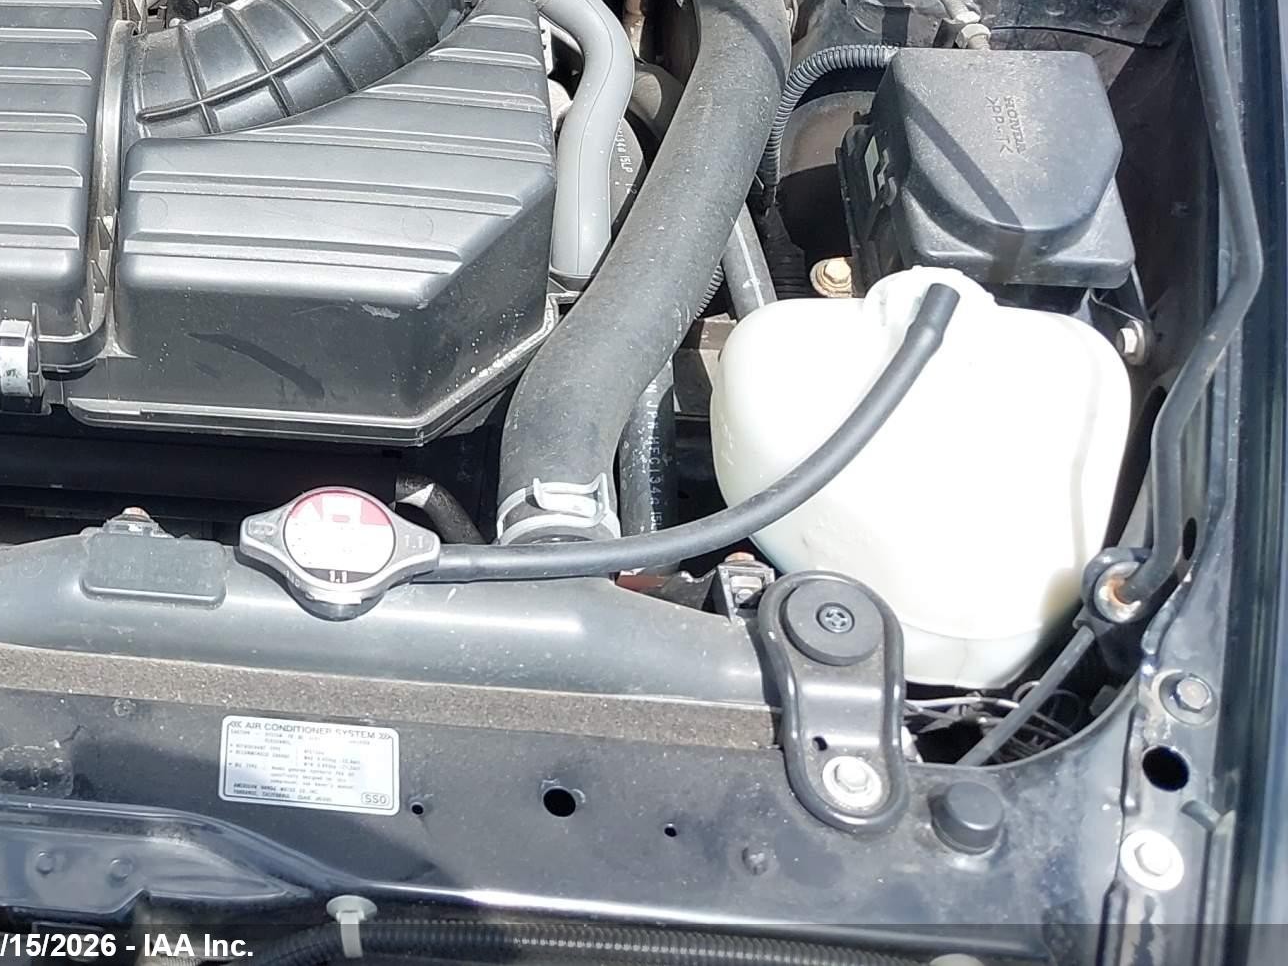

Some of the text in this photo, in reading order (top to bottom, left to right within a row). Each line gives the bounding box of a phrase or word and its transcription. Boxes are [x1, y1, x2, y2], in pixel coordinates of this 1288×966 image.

[404, 535, 424, 548] 1.1
[329, 570, 348, 583] 1.1
[245, 722, 262, 730] AIR
[264, 723, 332, 735] CONDITIONER
[335, 728, 376, 739] SYSTEM
